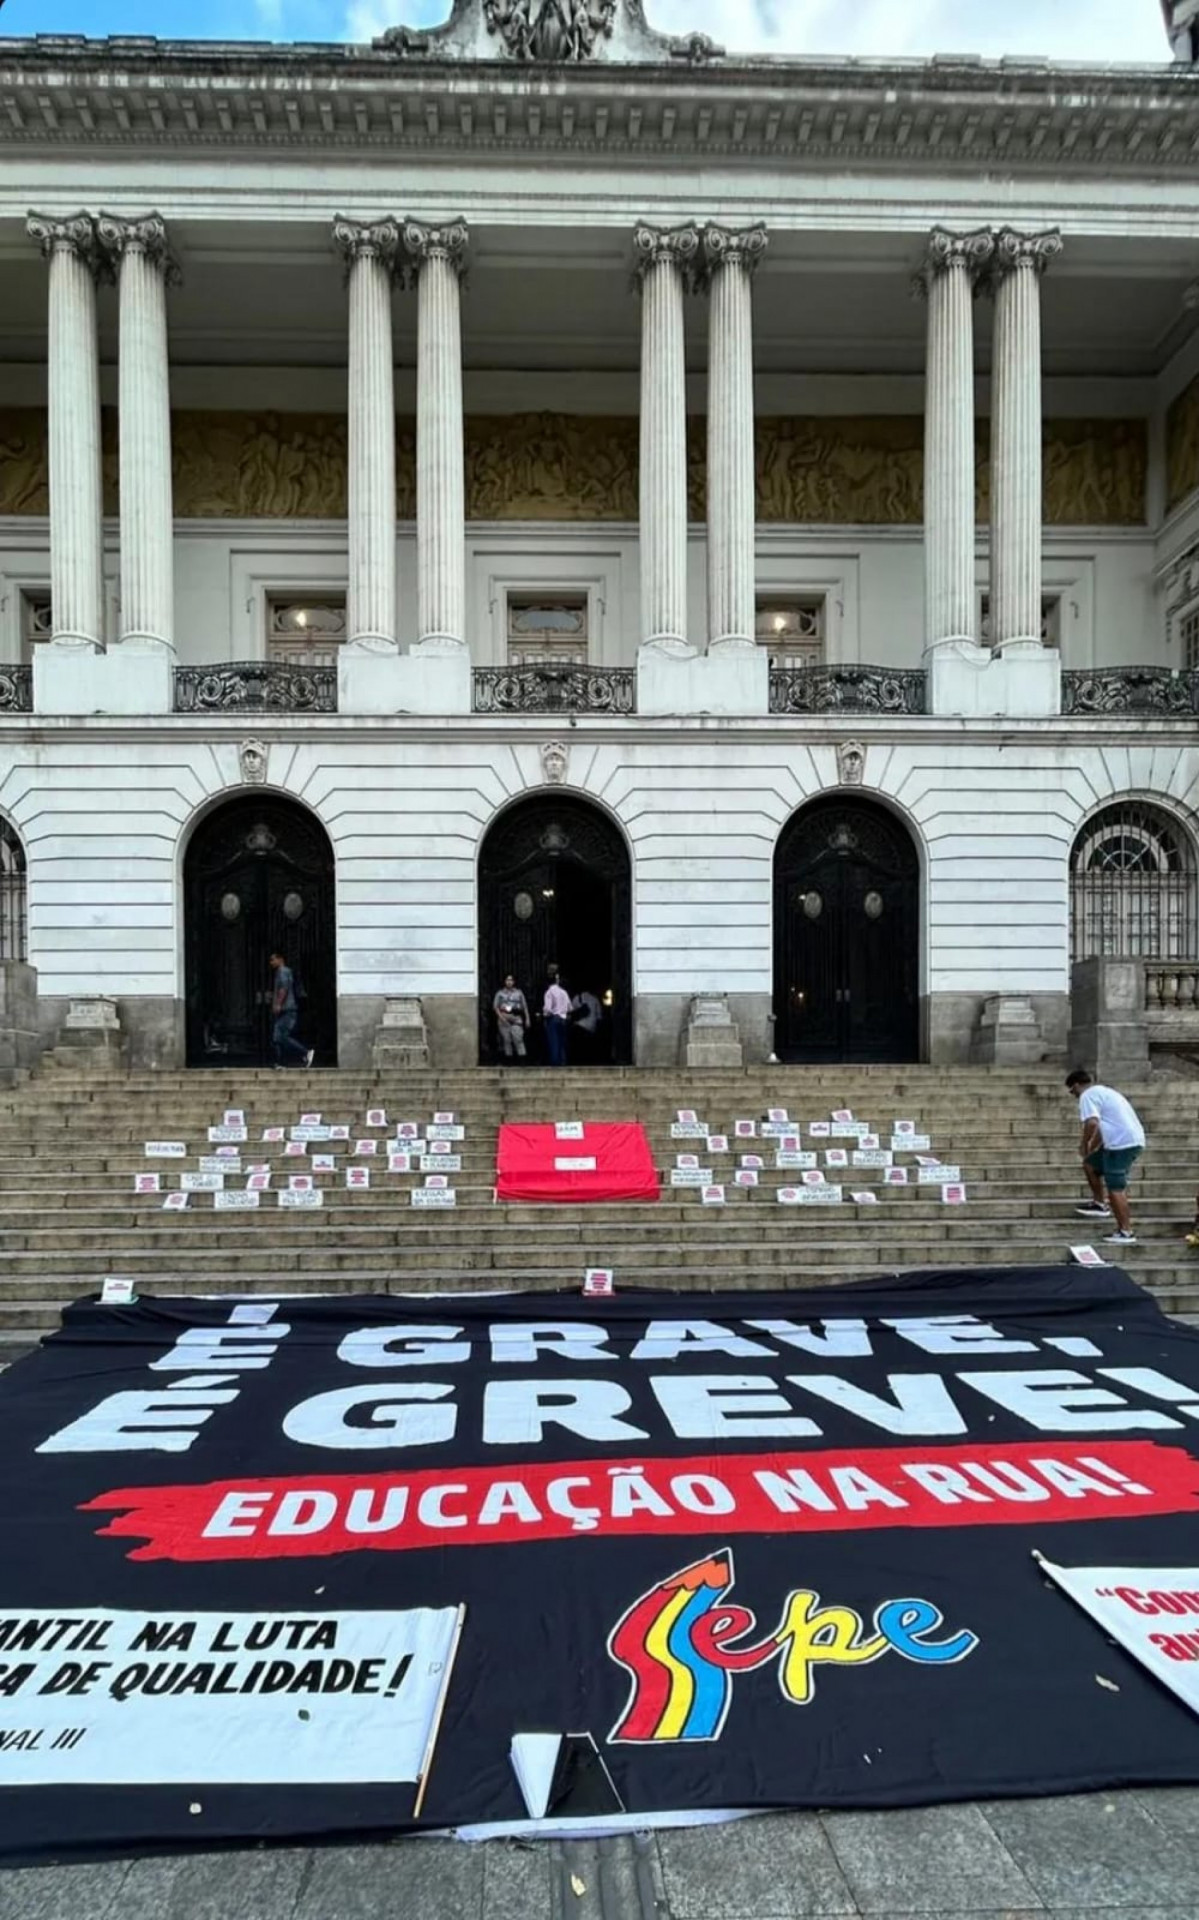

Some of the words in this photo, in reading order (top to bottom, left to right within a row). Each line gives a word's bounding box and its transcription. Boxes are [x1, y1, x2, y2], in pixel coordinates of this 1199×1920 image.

[148, 1303, 291, 1370] É
[34, 1374, 241, 1453] É
[281, 1367, 1199, 1449] GREVE!
[201, 1466, 737, 1538] EDUCAÇÃO
[752, 1466, 909, 1513] NA
[900, 1456, 1155, 1504] RUA!
[127, 1620, 197, 1651] NA
[208, 1619, 338, 1651] LUTA
[36, 1661, 114, 1696] DE
[108, 1653, 415, 1702] QUALIDADE!
[49, 1727, 88, 1750] III
